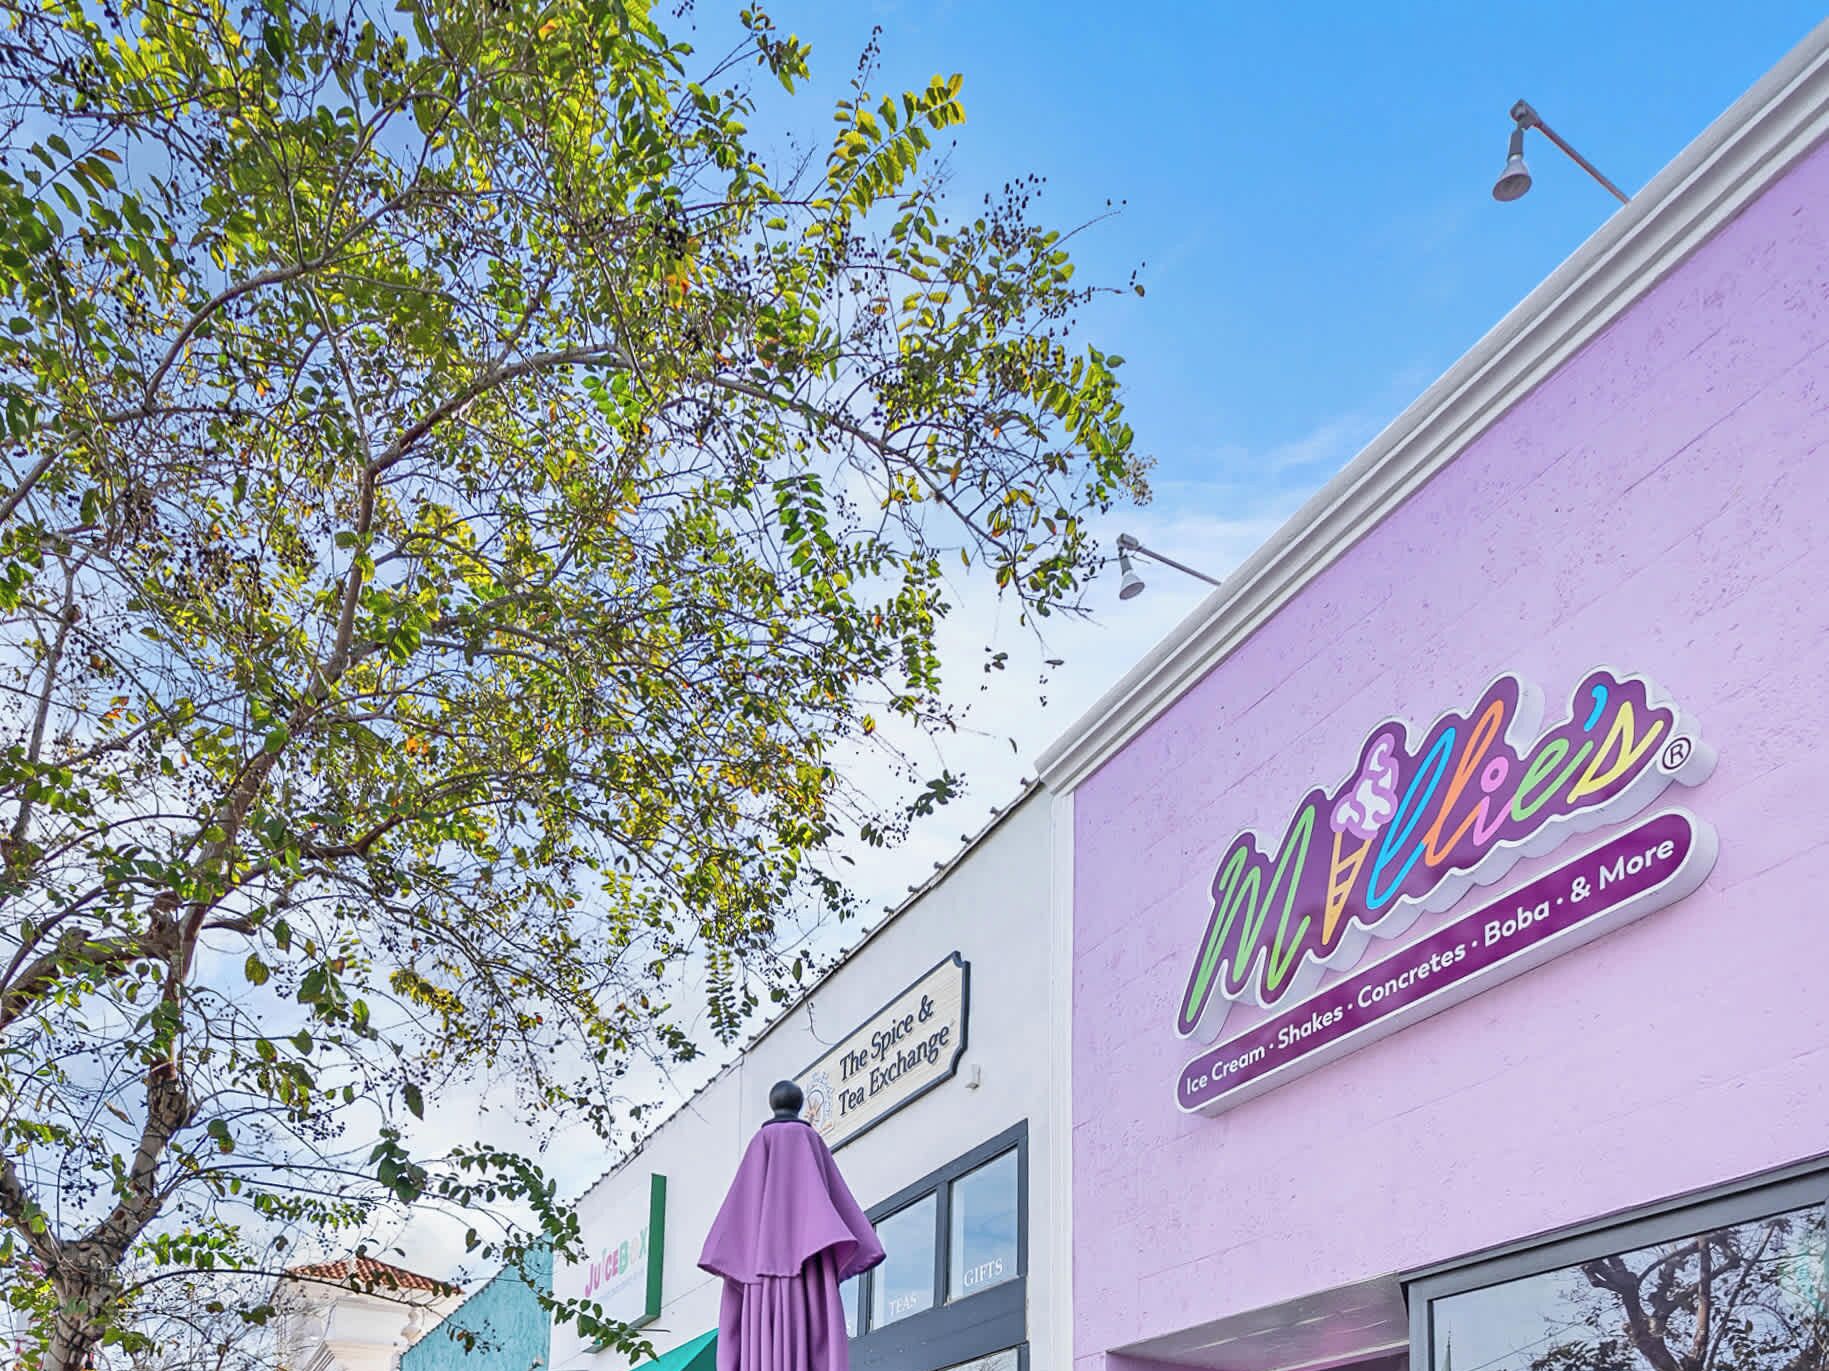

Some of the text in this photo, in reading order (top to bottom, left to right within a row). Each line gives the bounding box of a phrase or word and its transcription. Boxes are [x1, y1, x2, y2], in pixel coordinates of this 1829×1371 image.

[1185, 839, 1675, 1096] Ice Cream Shakes Concretes Boba & More
[838, 1025, 950, 1117] Tea Exchange
[839, 994, 934, 1082] The Spice &
[888, 1292, 918, 1317] TEAS
[963, 1257, 1003, 1288] GIFTS
